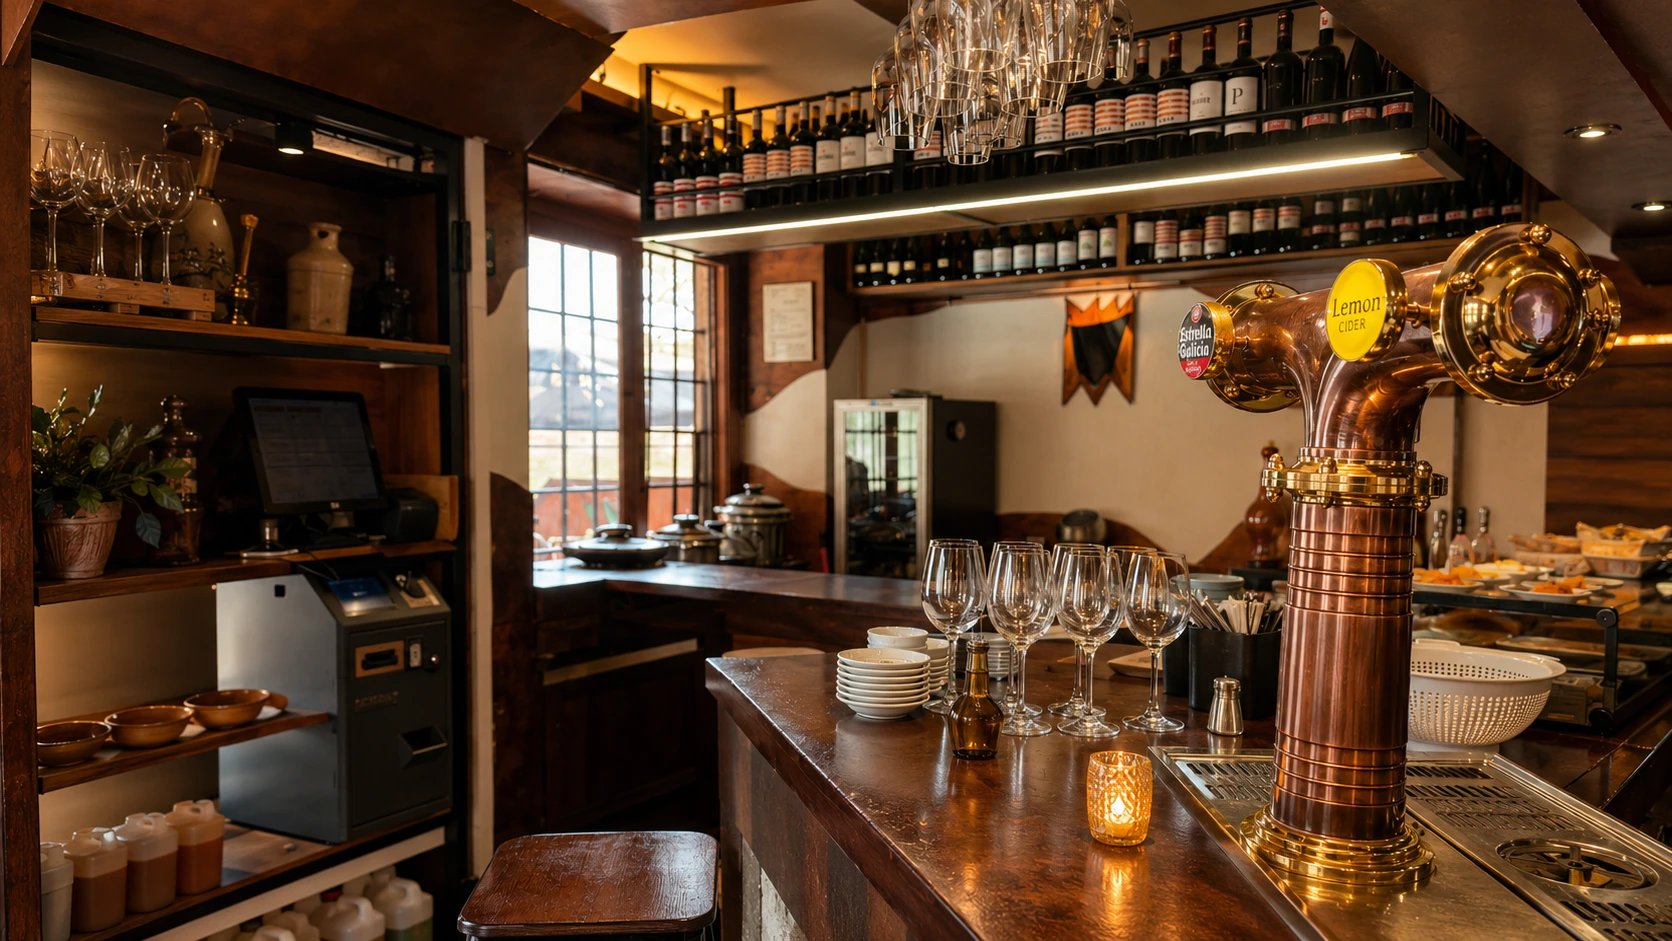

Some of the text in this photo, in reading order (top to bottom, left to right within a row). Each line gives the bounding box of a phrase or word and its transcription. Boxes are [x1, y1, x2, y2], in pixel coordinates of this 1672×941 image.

[1232, 87, 1243, 105] P
[1332, 296, 1380, 318] Lemon
[1180, 324, 1212, 342] Estrella
[1338, 318, 1366, 333] CIDER
[1180, 340, 1209, 359] Galicia
